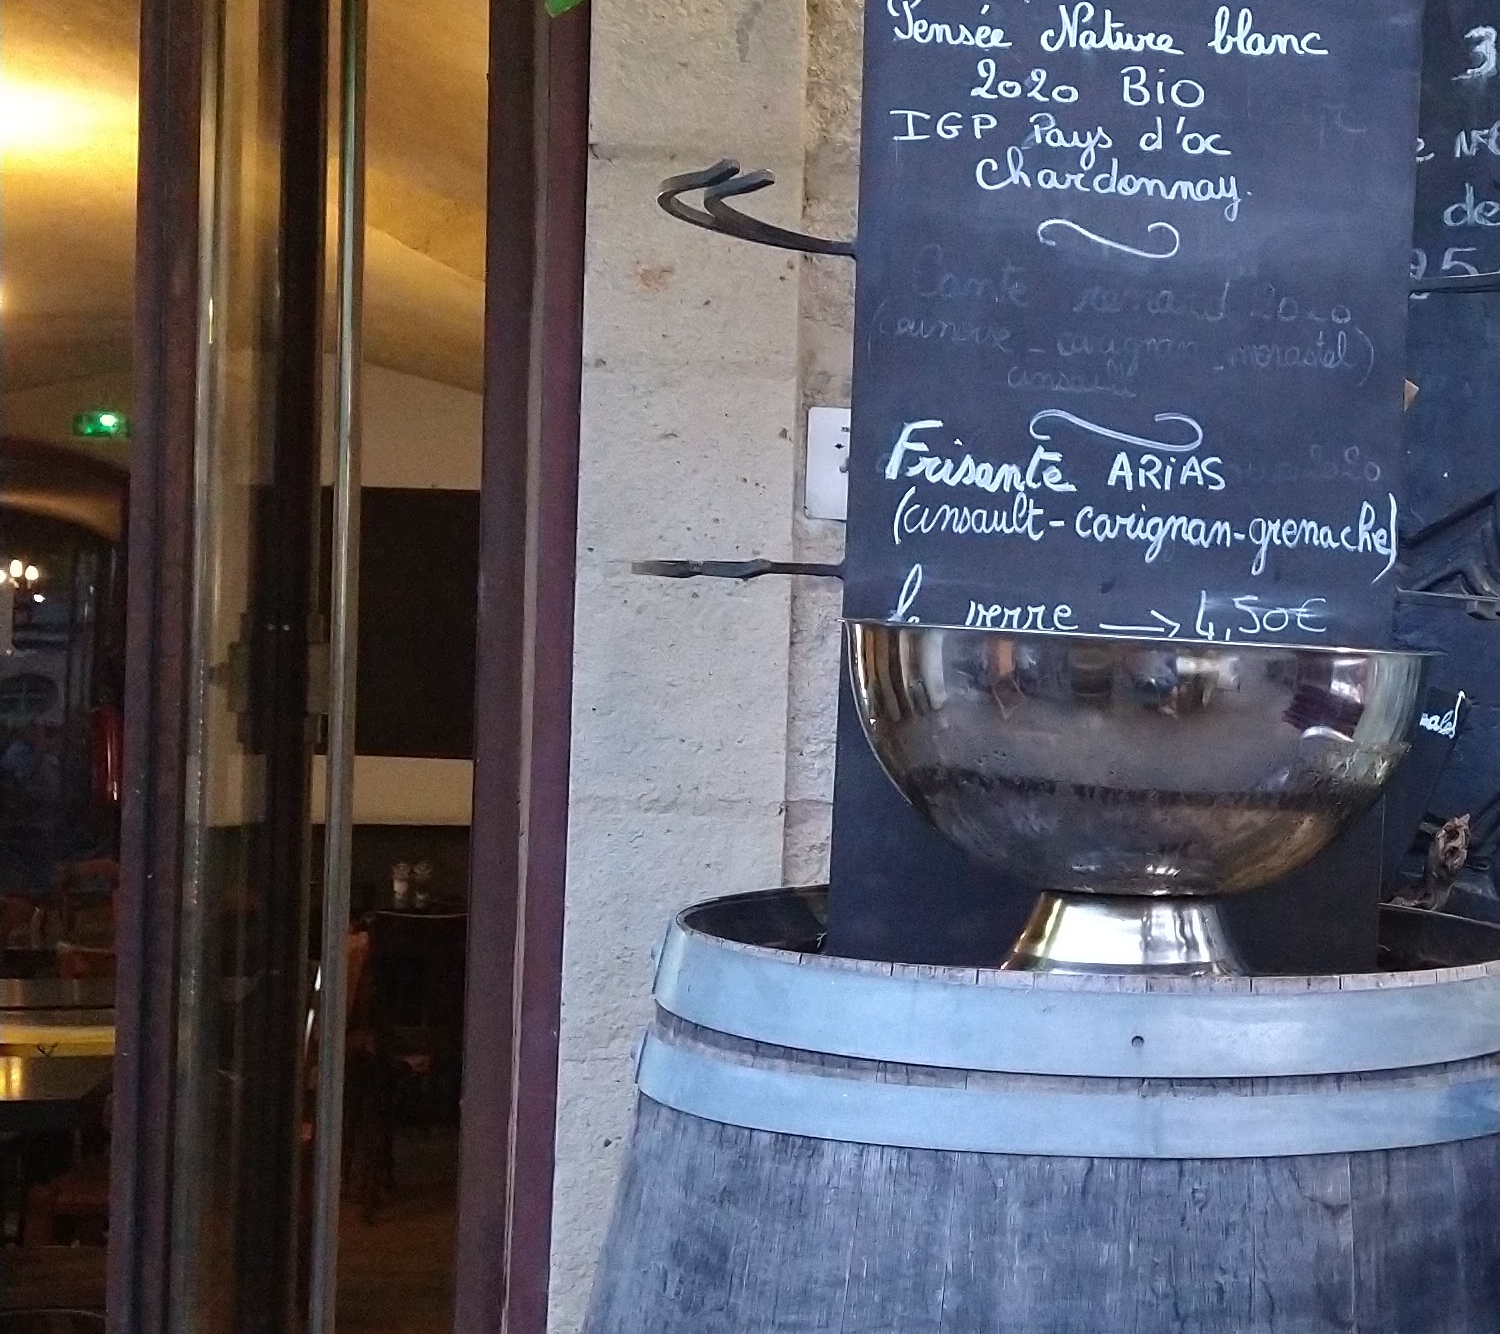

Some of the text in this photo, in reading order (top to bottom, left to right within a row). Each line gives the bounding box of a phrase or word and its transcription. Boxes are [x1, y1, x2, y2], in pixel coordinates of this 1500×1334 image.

[1040, 1, 1185, 55] Nature
[1208, 6, 1330, 56] blanc
[970, 58, 1080, 104] 2020
[890, 109, 998, 142] IGP
[1031, 114, 1114, 169] Pays
[885, 420, 1078, 492] Frisante
[965, 600, 1079, 631] verre
